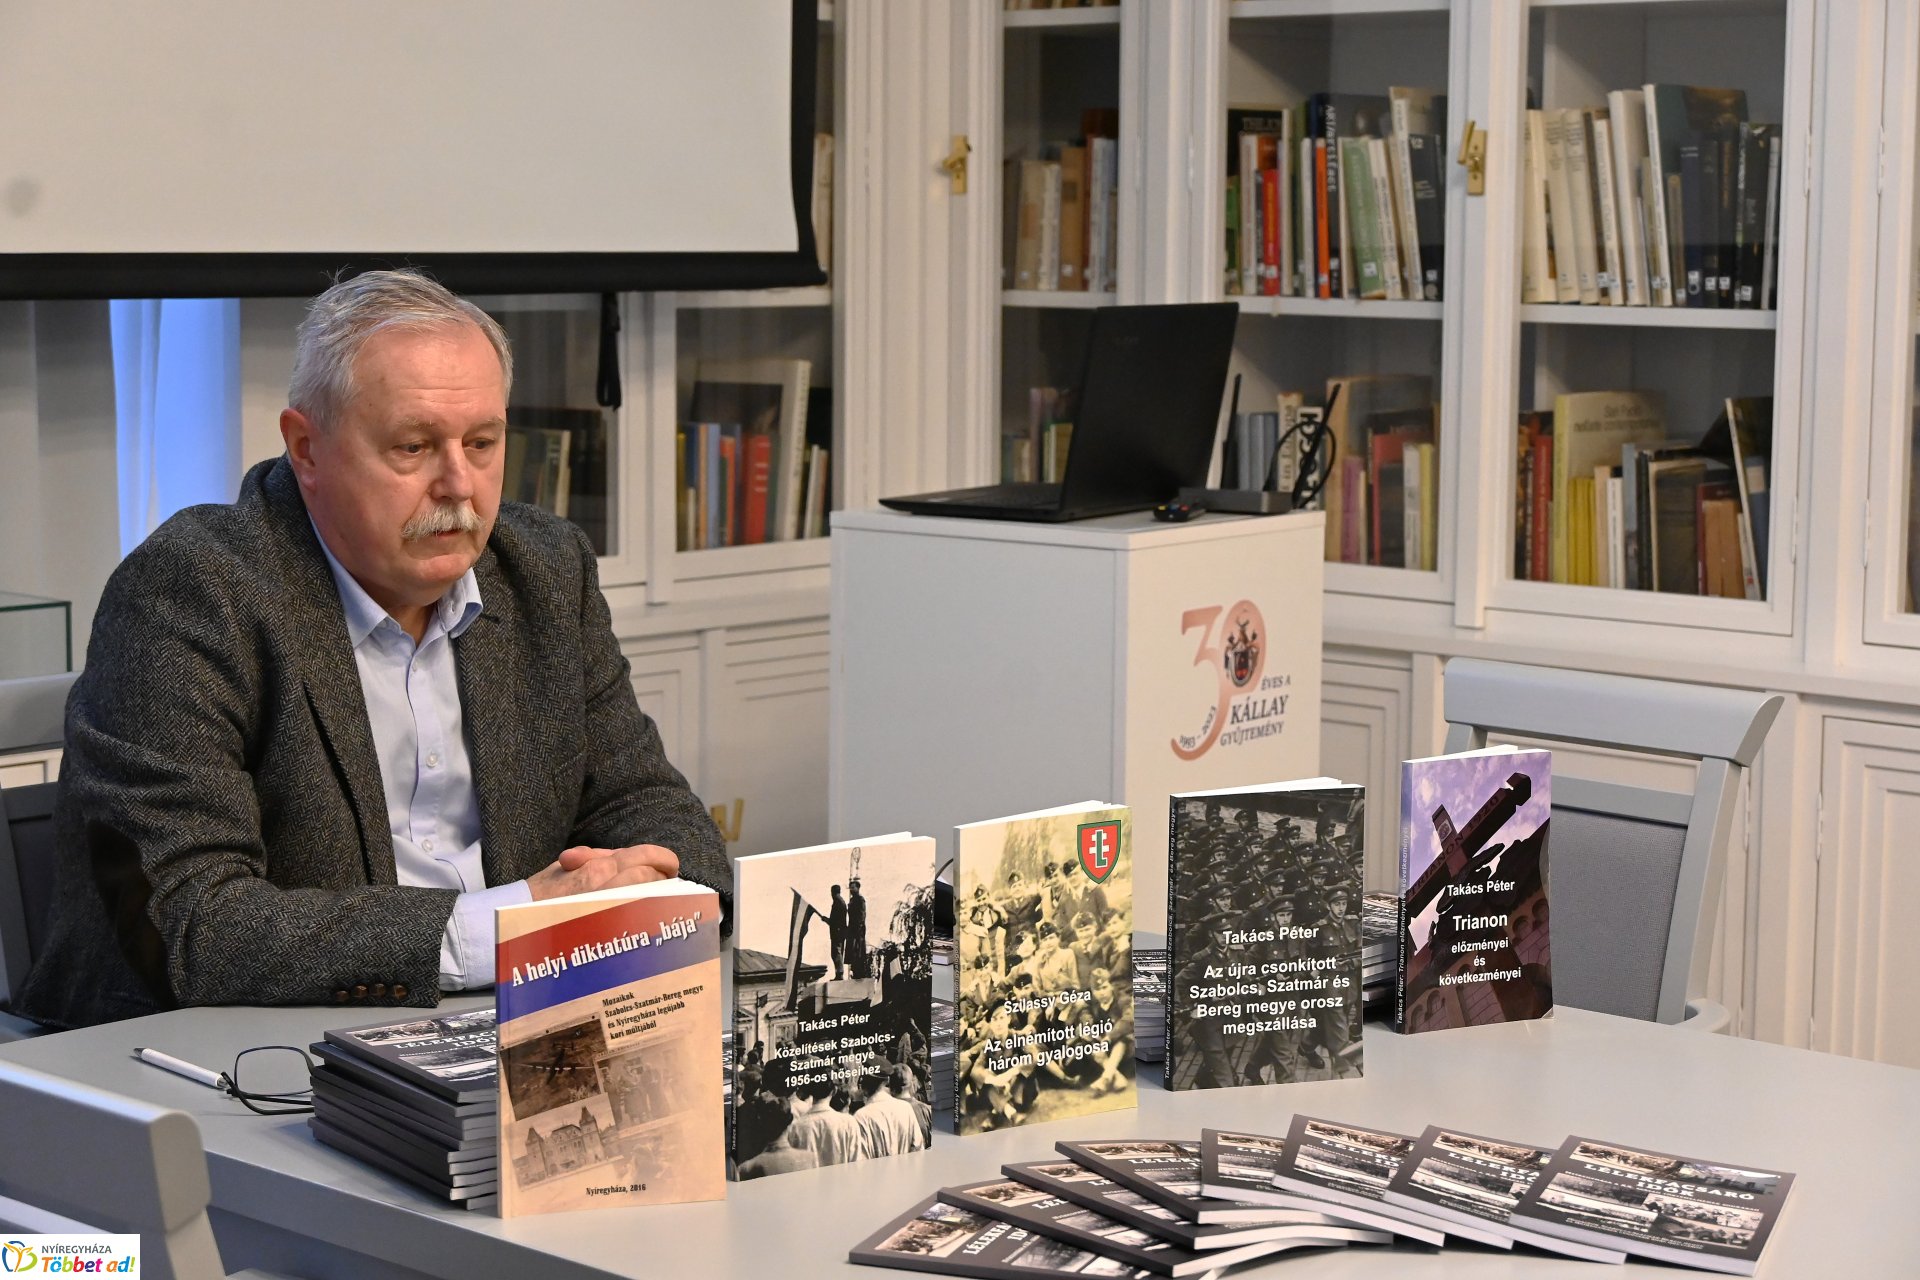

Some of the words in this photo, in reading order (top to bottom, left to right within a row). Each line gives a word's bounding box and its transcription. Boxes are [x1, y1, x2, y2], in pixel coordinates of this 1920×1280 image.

[1261, 675, 1283, 690] ÉVES
[1284, 675, 1291, 685] A
[1230, 695, 1289, 725] KÁLLAY
[1447, 883, 1483, 897] Takács
[1486, 879, 1515, 893] Péter
[1452, 914, 1508, 931] Trianon
[1223, 928, 1274, 944] Takács
[1279, 926, 1319, 941] Péter
[1451, 938, 1509, 954] előzményei
[513, 967, 523, 986] A
[525, 952, 567, 979] helyi
[571, 931, 650, 967] diktatúra
[1203, 965, 1224, 979] Az
[1228, 963, 1256, 979] újra
[1261, 956, 1337, 975] csonkított
[1473, 955, 1486, 967] és
[1439, 967, 1522, 986] következményei
[1189, 982, 1262, 999] Szabolcs,
[1267, 976, 1328, 993] Szatmár
[1332, 975, 1350, 988] és
[602, 992, 635, 1007] Mozaikok
[604, 991, 682, 1018] Szabolcs-Szatmár-Bereg
[683, 985, 704, 996] megye
[1004, 995, 1057, 1015] Szilassy
[1059, 988, 1091, 1004] Géza
[1197, 1003, 1241, 1019] Bereg
[1246, 1000, 1296, 1015] megye
[1300, 996, 1343, 1009] orosz
[607, 1021, 616, 1029] és
[616, 1011, 656, 1028] Nyíregyháza
[657, 1001, 685, 1015] legújabb
[799, 1019, 837, 1032] Takács
[841, 1014, 870, 1026] Péter
[1166, 1013, 1171, 1024] Az
[610, 1030, 624, 1040] kori
[625, 1020, 657, 1035] múltjából
[983, 1036, 1002, 1054] Az
[1005, 1023, 1076, 1048] elnémított
[1078, 1018, 1113, 1037] légió
[1223, 1017, 1317, 1036] megszállása
[774, 1040, 838, 1059] Közelítések
[840, 1033, 895, 1048] Szabolcs-
[988, 1050, 1033, 1072] három
[1036, 1040, 1110, 1068] gyalogosa
[790, 1055, 835, 1072] Szatmár
[838, 1051, 875, 1064] megye
[784, 1073, 828, 1088] 1956-os
[831, 1065, 881, 1080] hőseihez
[586, 1185, 628, 1197] Nyíregyháza,
